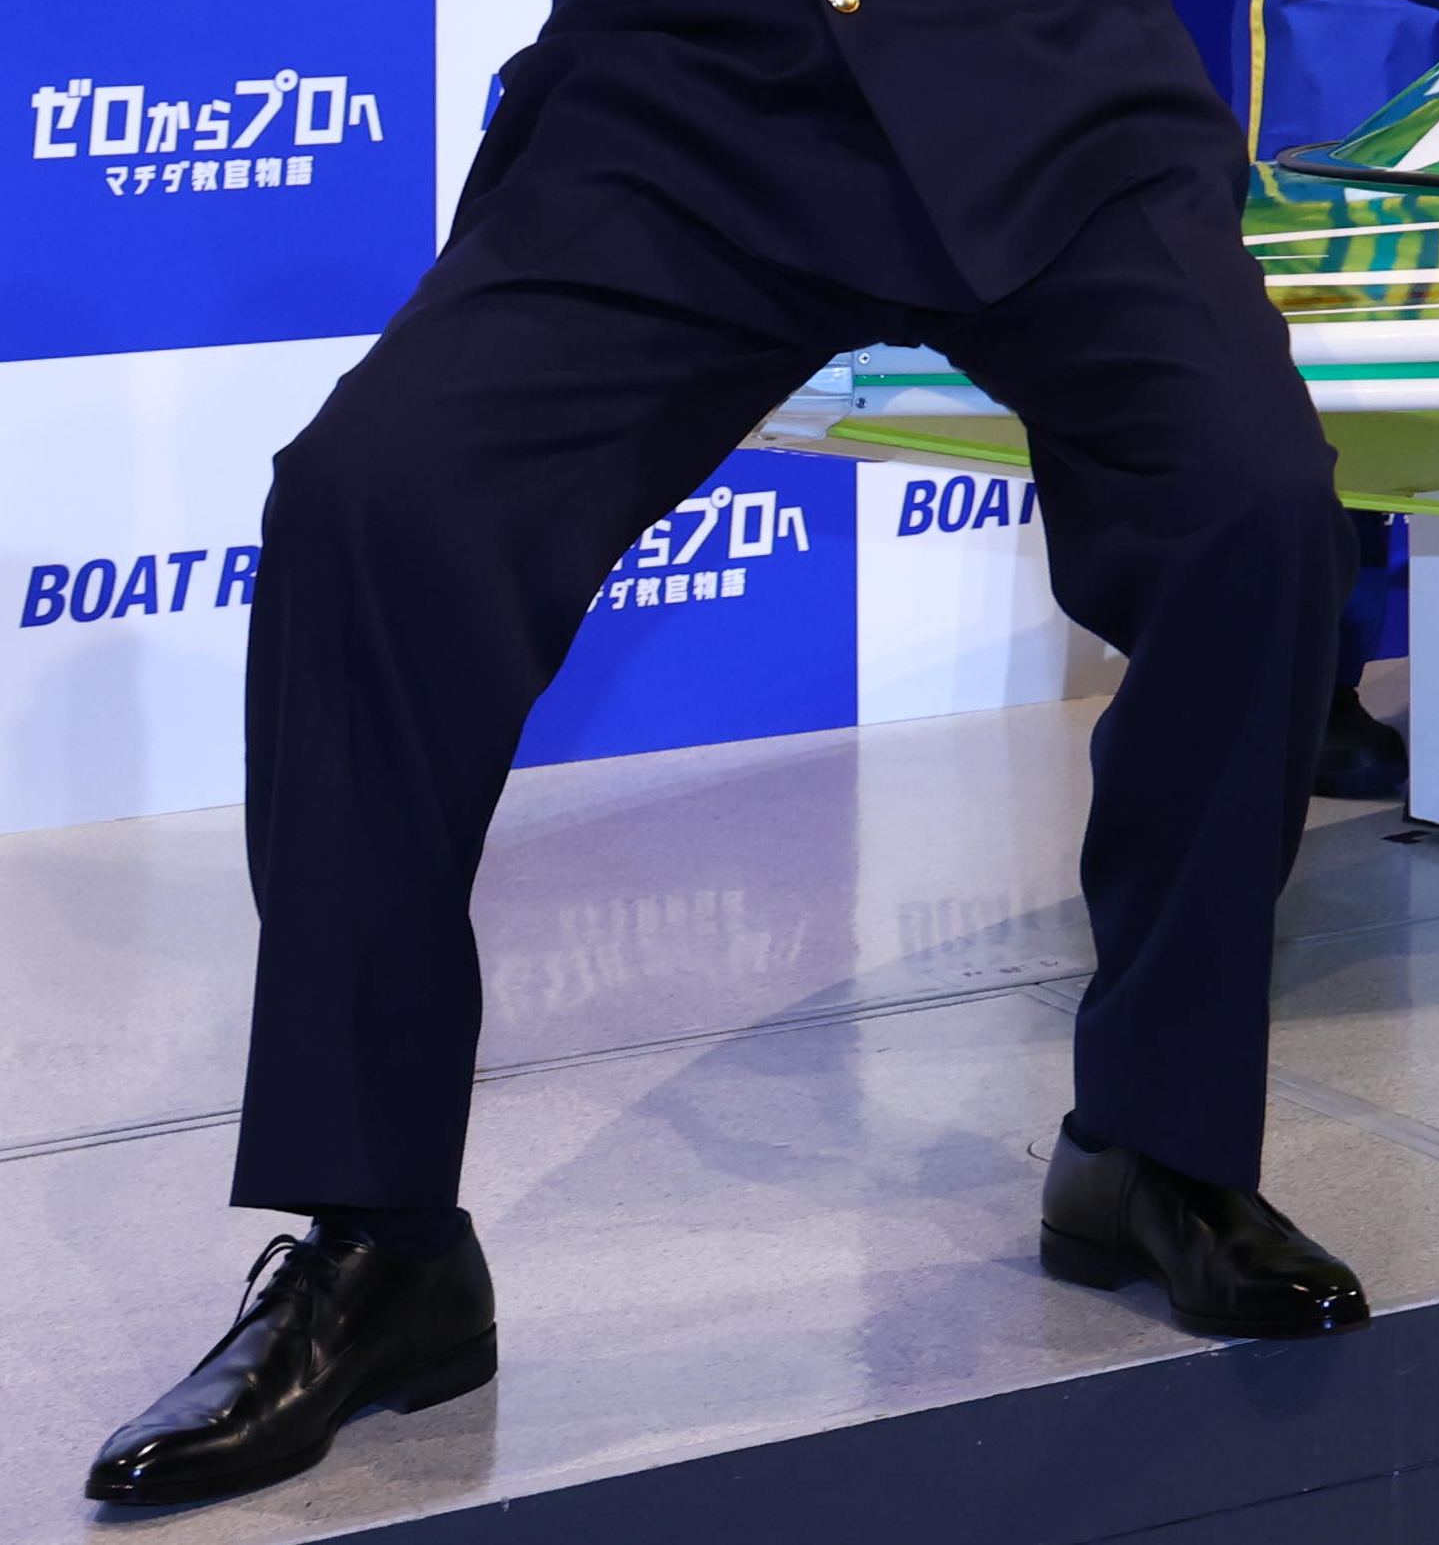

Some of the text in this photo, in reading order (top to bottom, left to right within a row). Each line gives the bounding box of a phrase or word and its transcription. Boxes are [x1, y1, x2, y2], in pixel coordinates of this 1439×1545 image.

[32, 70, 382, 158] ゼロからプロへ
[107, 156, 313, 195] マチダ教官物語
[613, 486, 809, 571] らプロへ
[19, 550, 208, 628] BOAT
[588, 568, 747, 613] ダ教官物語
